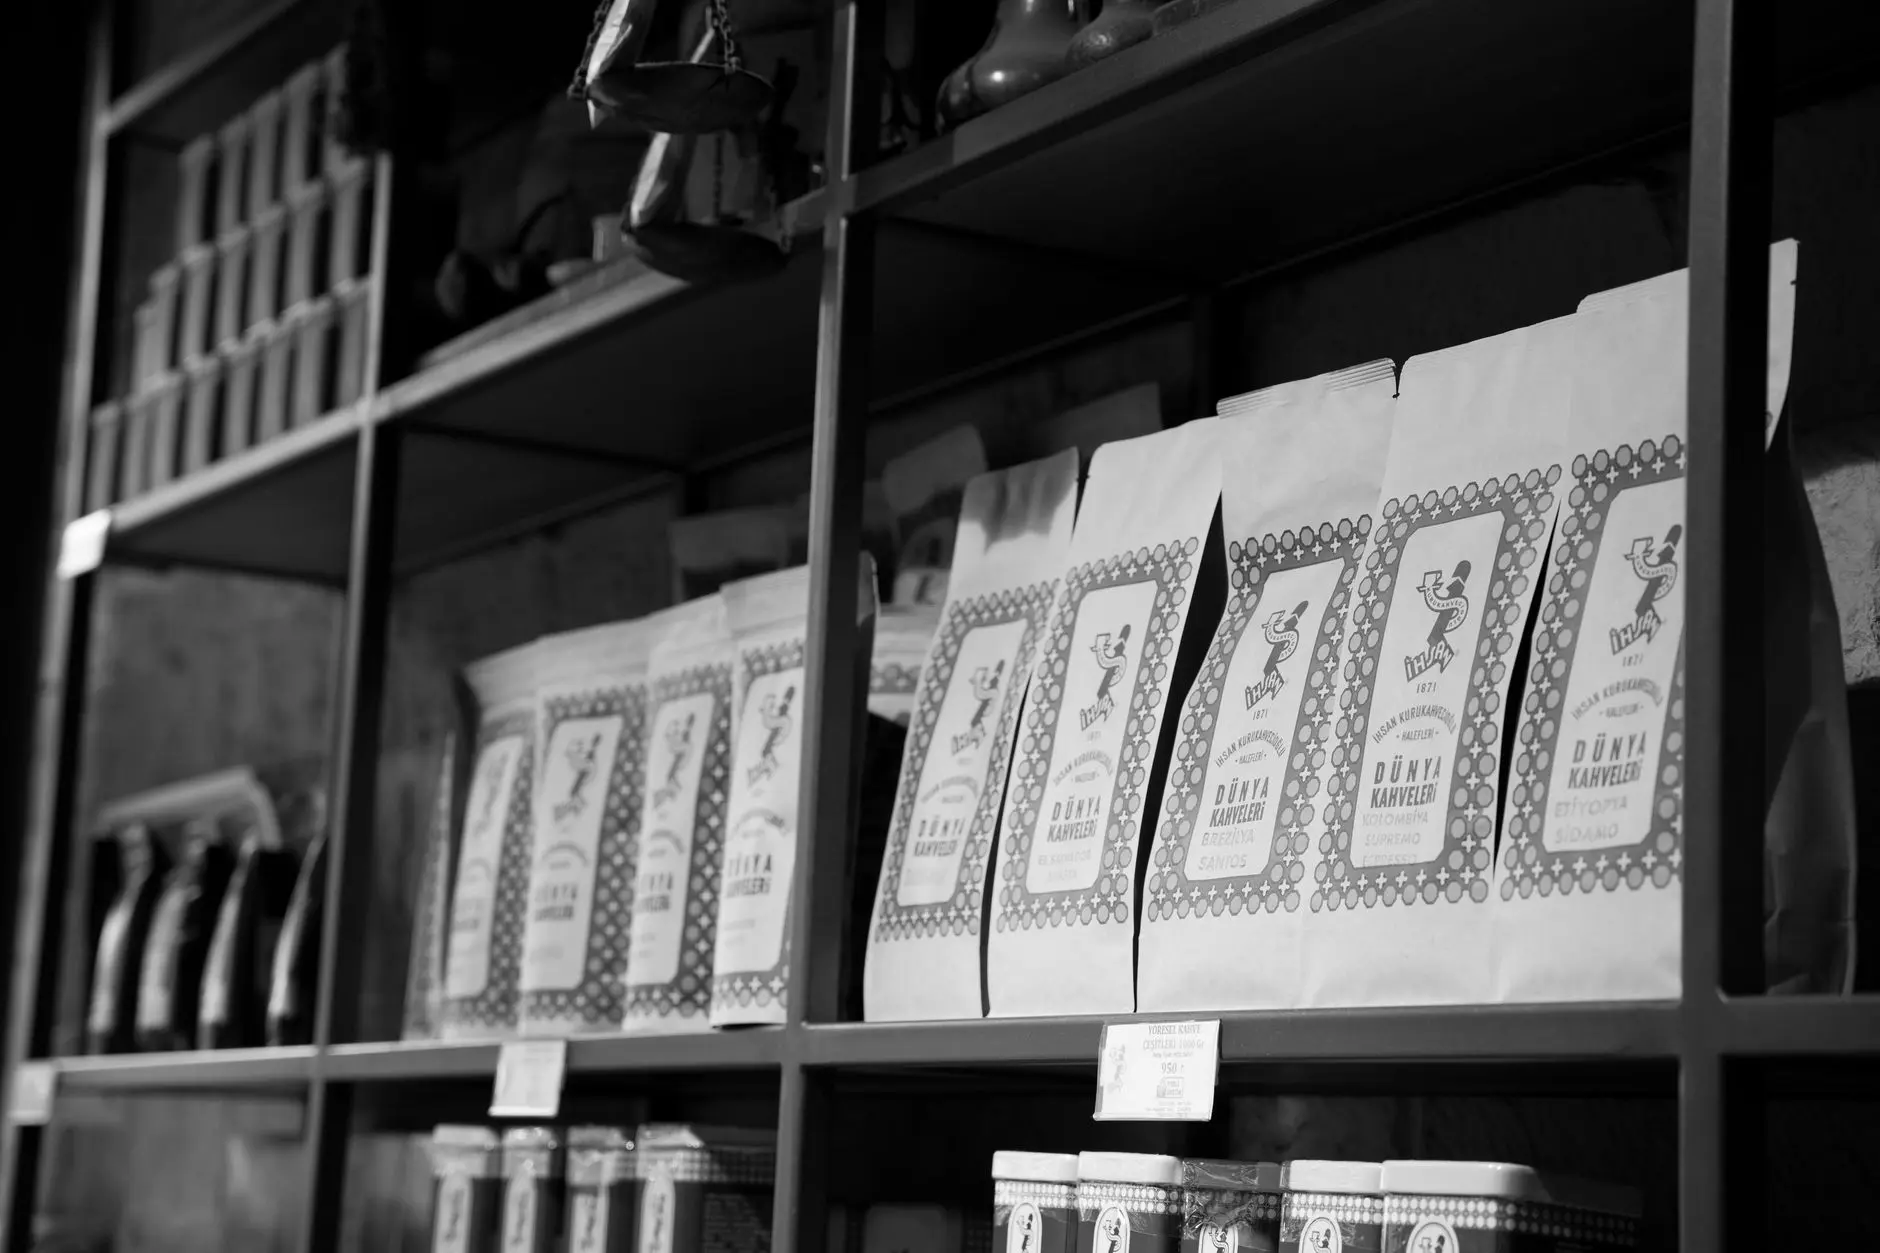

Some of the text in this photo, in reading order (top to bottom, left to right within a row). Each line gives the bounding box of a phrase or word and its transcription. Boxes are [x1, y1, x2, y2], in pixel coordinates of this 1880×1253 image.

[1416, 682, 1437, 694] 1871
[1252, 709, 1268, 721] 1871
[1572, 731, 1646, 764] DÜNYA
[1374, 755, 1441, 785] DÜNYA
[1214, 777, 1269, 806] DÜNYA
[1370, 782, 1438, 809] KAHVELERİ
[1051, 794, 1101, 822] DÜNYA
[1209, 801, 1266, 828] KAHVELERİ
[1047, 818, 1098, 843] KAHVELERİ
[1198, 854, 1248, 871] SANTOS
[1161, 1062, 1177, 1074] 950
